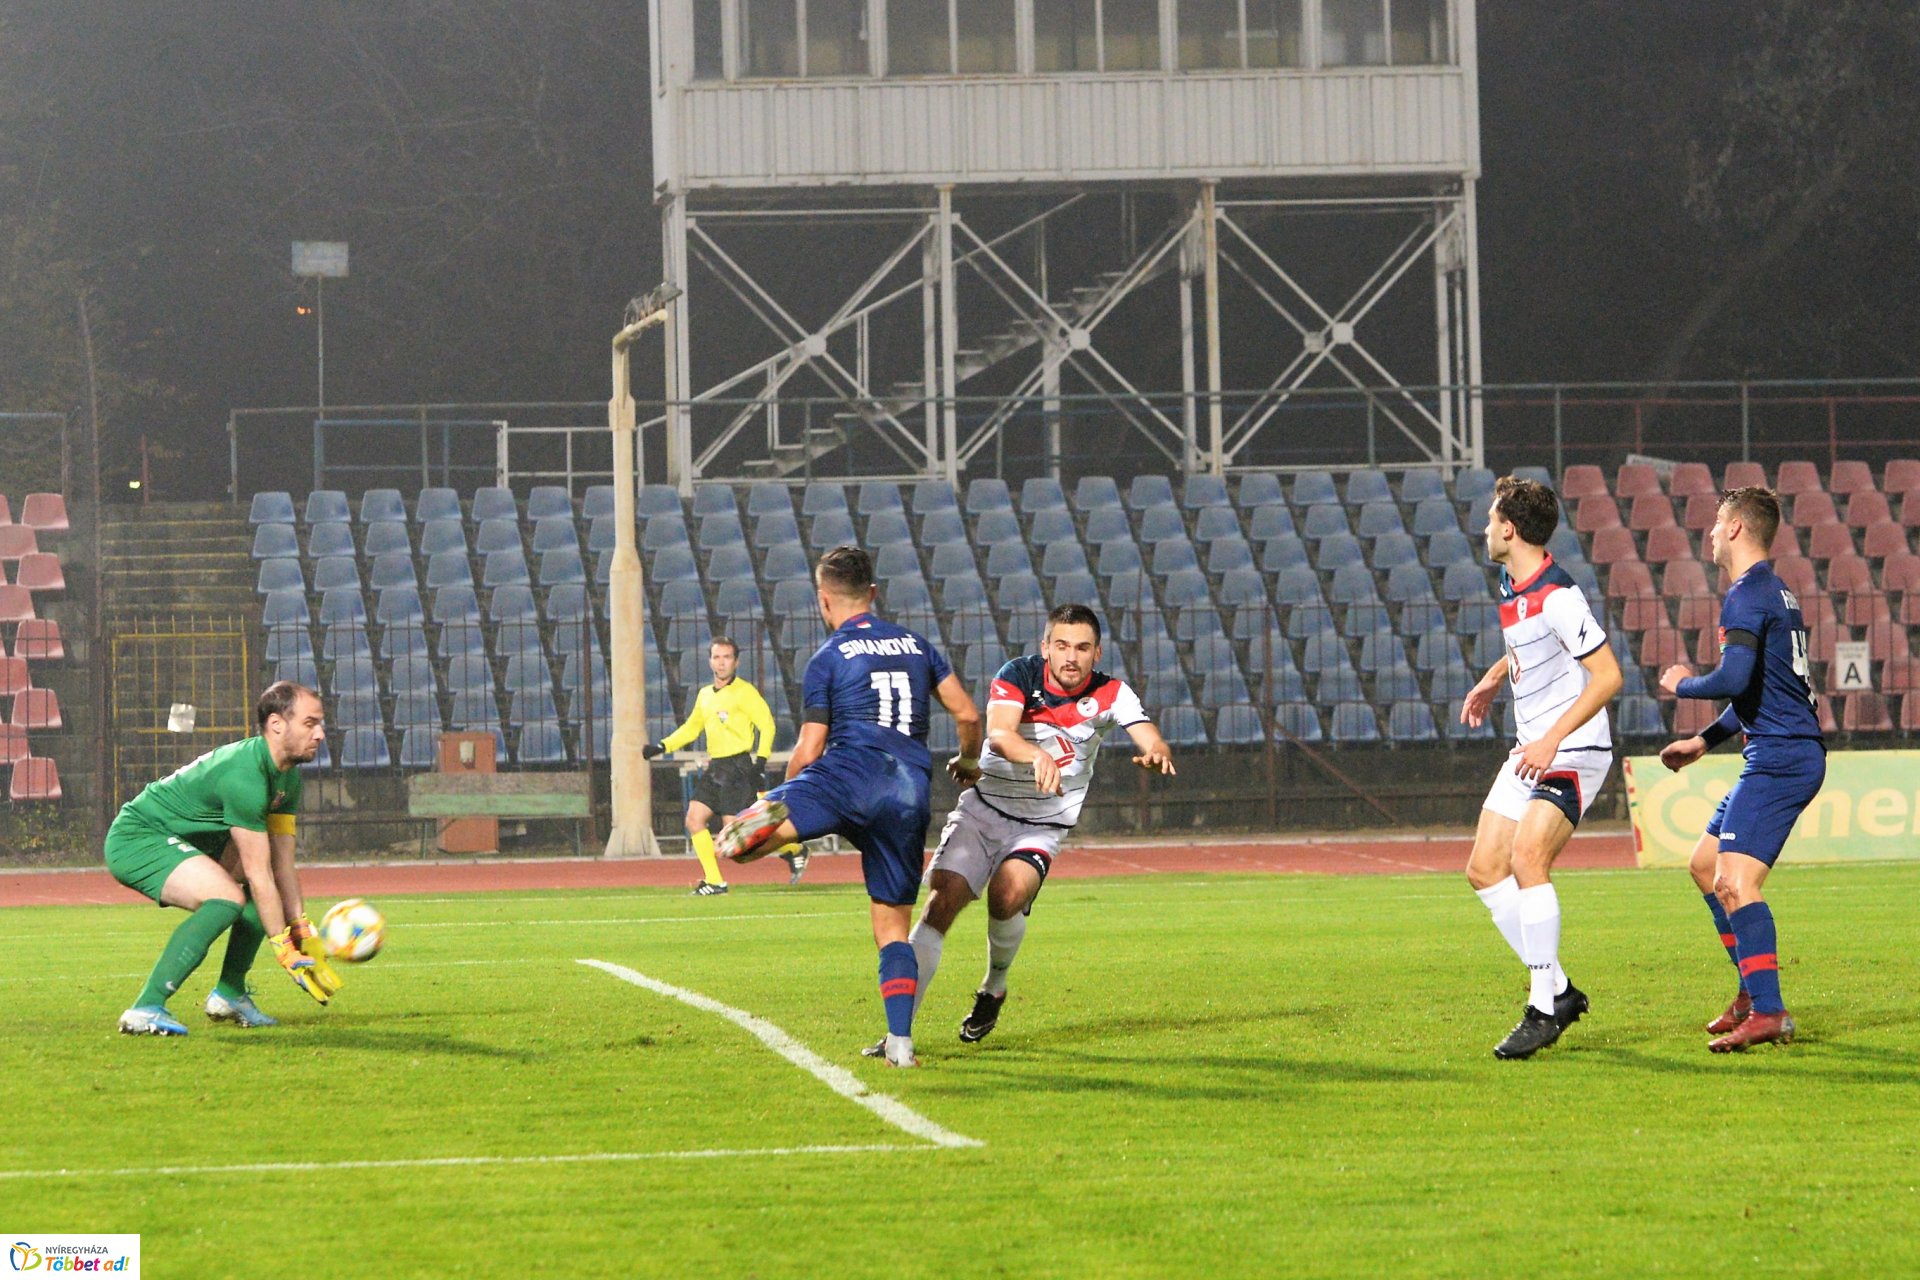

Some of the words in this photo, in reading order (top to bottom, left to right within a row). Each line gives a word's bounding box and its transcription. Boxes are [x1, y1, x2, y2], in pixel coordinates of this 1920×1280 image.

[838, 633, 923, 660] SINANOVIĆ
[1844, 661, 1862, 684] A
[870, 671, 913, 737] 11
